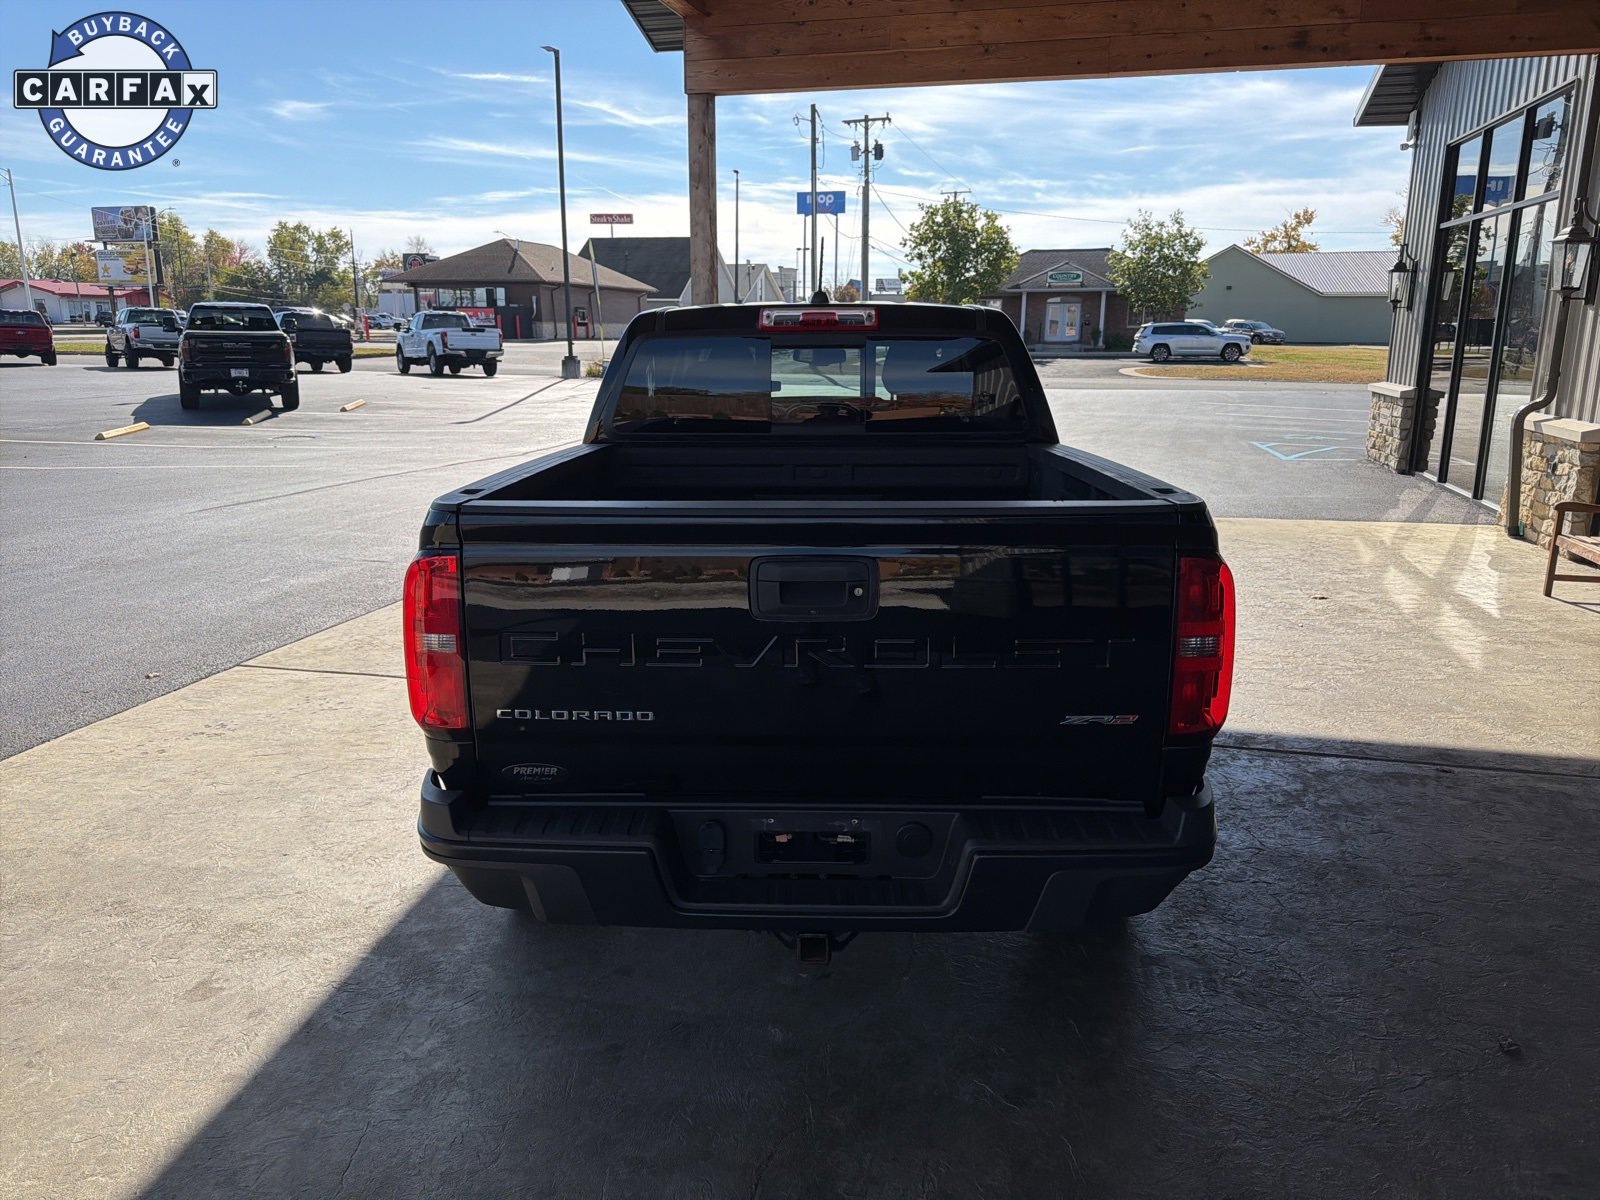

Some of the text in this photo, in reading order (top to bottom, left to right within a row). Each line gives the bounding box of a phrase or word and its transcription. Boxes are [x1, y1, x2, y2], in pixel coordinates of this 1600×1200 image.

[500, 632, 1137, 668] CHEVROLET
[496, 709, 655, 721] COLORADO
[513, 767, 558, 776] PREMIER
